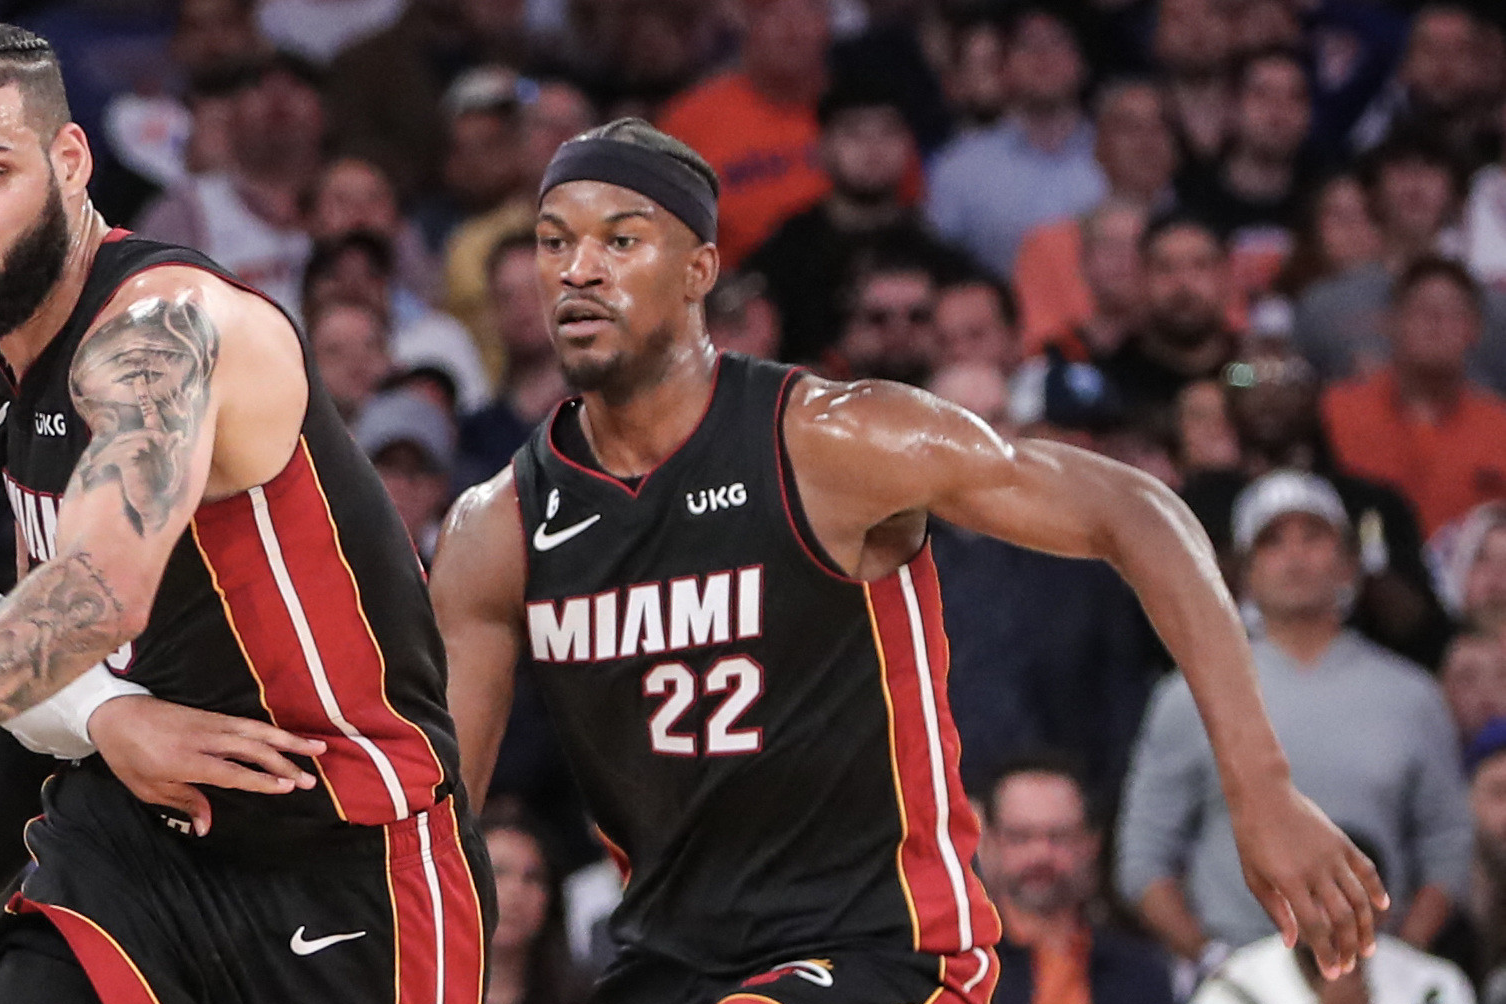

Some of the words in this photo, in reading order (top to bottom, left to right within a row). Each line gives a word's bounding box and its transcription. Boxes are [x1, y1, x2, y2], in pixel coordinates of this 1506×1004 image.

[546, 488, 560, 520] 6
[526, 563, 764, 664] MIAMI
[642, 653, 764, 757] 22
